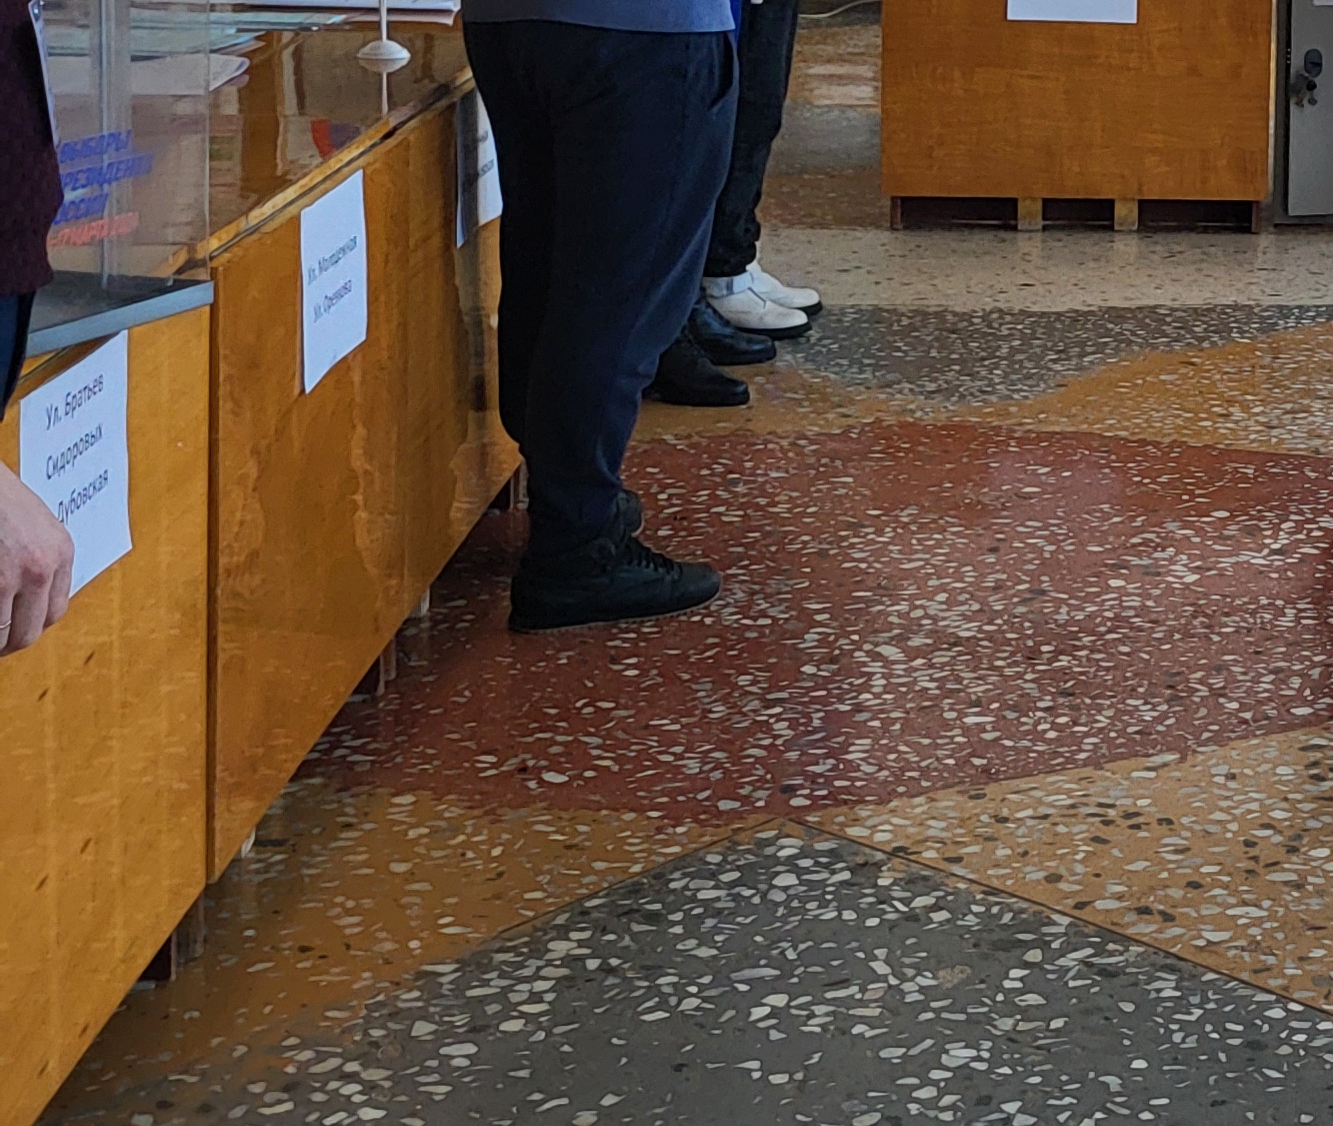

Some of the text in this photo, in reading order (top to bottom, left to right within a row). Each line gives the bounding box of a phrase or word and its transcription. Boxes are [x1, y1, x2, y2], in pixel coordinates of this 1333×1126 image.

[46, 374, 104, 431] Ул. Братьев
[46, 424, 103, 480] Сидоровых
[57, 469, 109, 526] Дубовская
